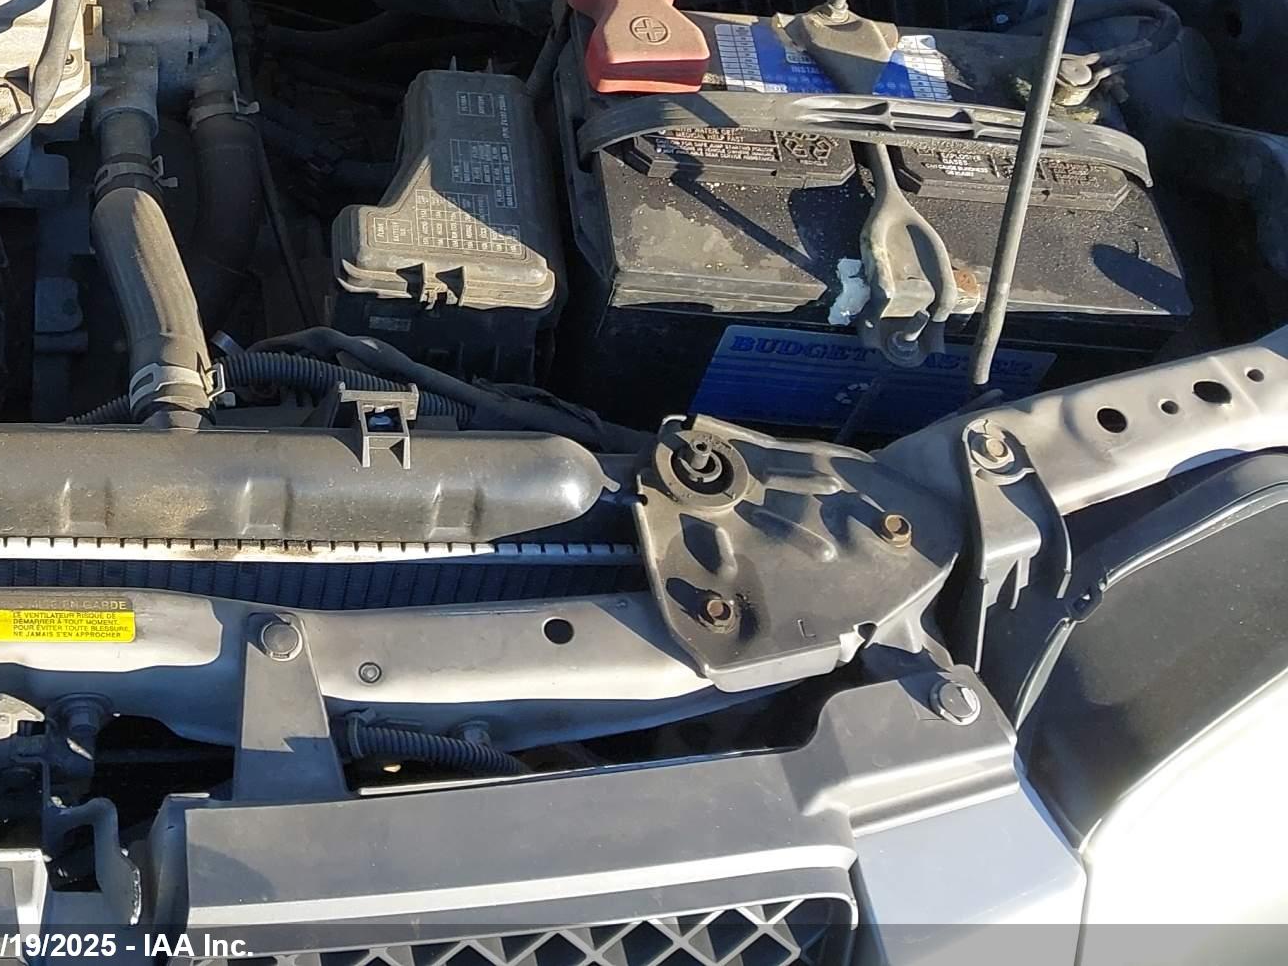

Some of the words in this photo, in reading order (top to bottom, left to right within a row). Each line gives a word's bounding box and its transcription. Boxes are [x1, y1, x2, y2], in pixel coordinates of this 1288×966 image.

[942, 158, 968, 166] GASES
[733, 335, 869, 362] BUDGET
[82, 601, 127, 610] GARDE
[797, 618, 817, 638] L
